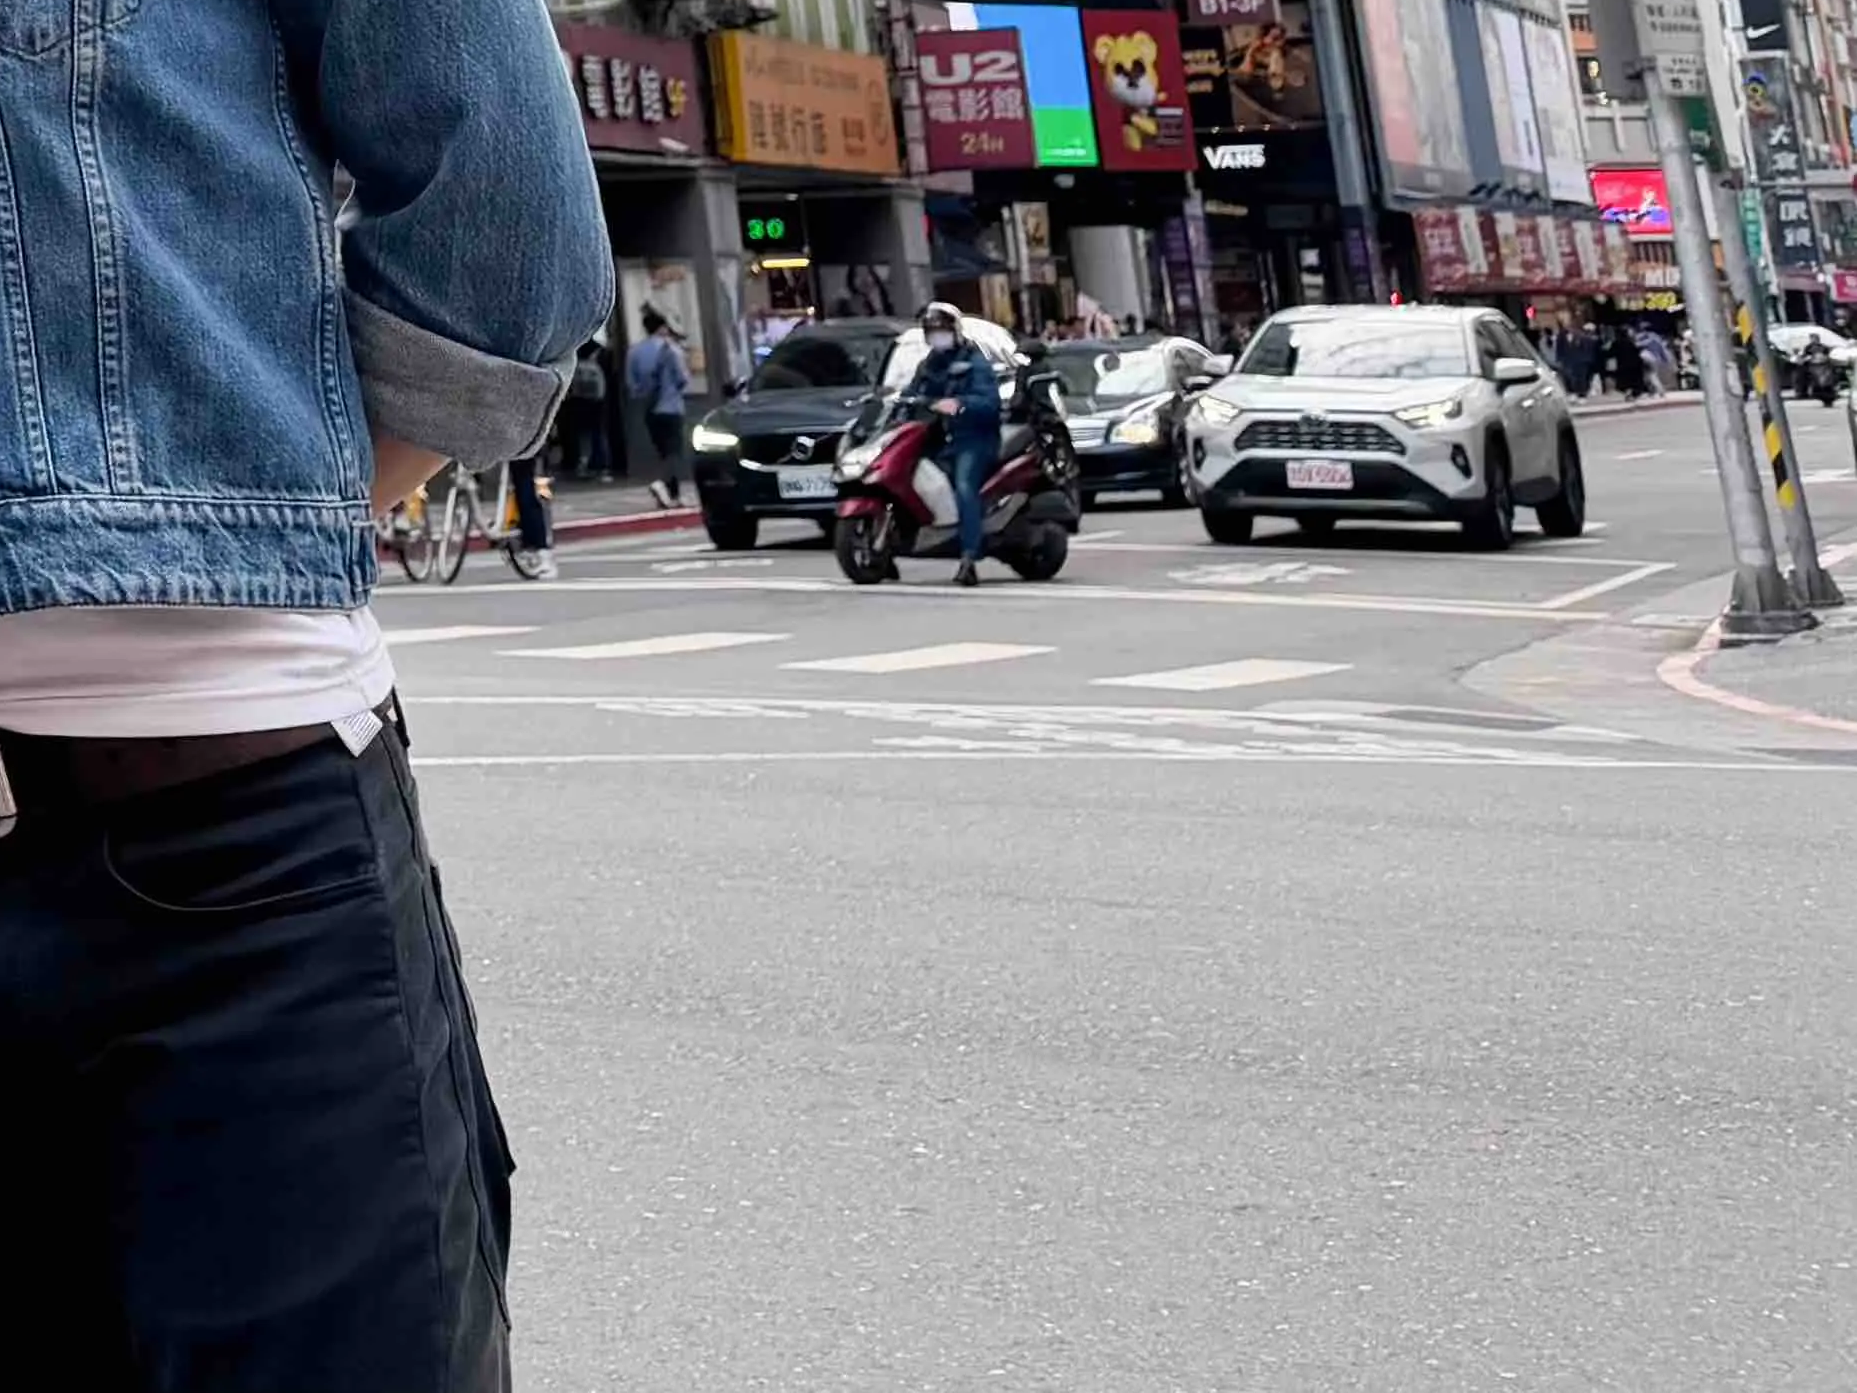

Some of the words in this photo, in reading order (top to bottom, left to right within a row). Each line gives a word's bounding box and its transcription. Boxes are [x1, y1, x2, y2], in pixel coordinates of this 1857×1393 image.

[919, 50, 1020, 86] U2
[924, 86, 1024, 124] 電影館
[1203, 143, 1267, 170] VANS
